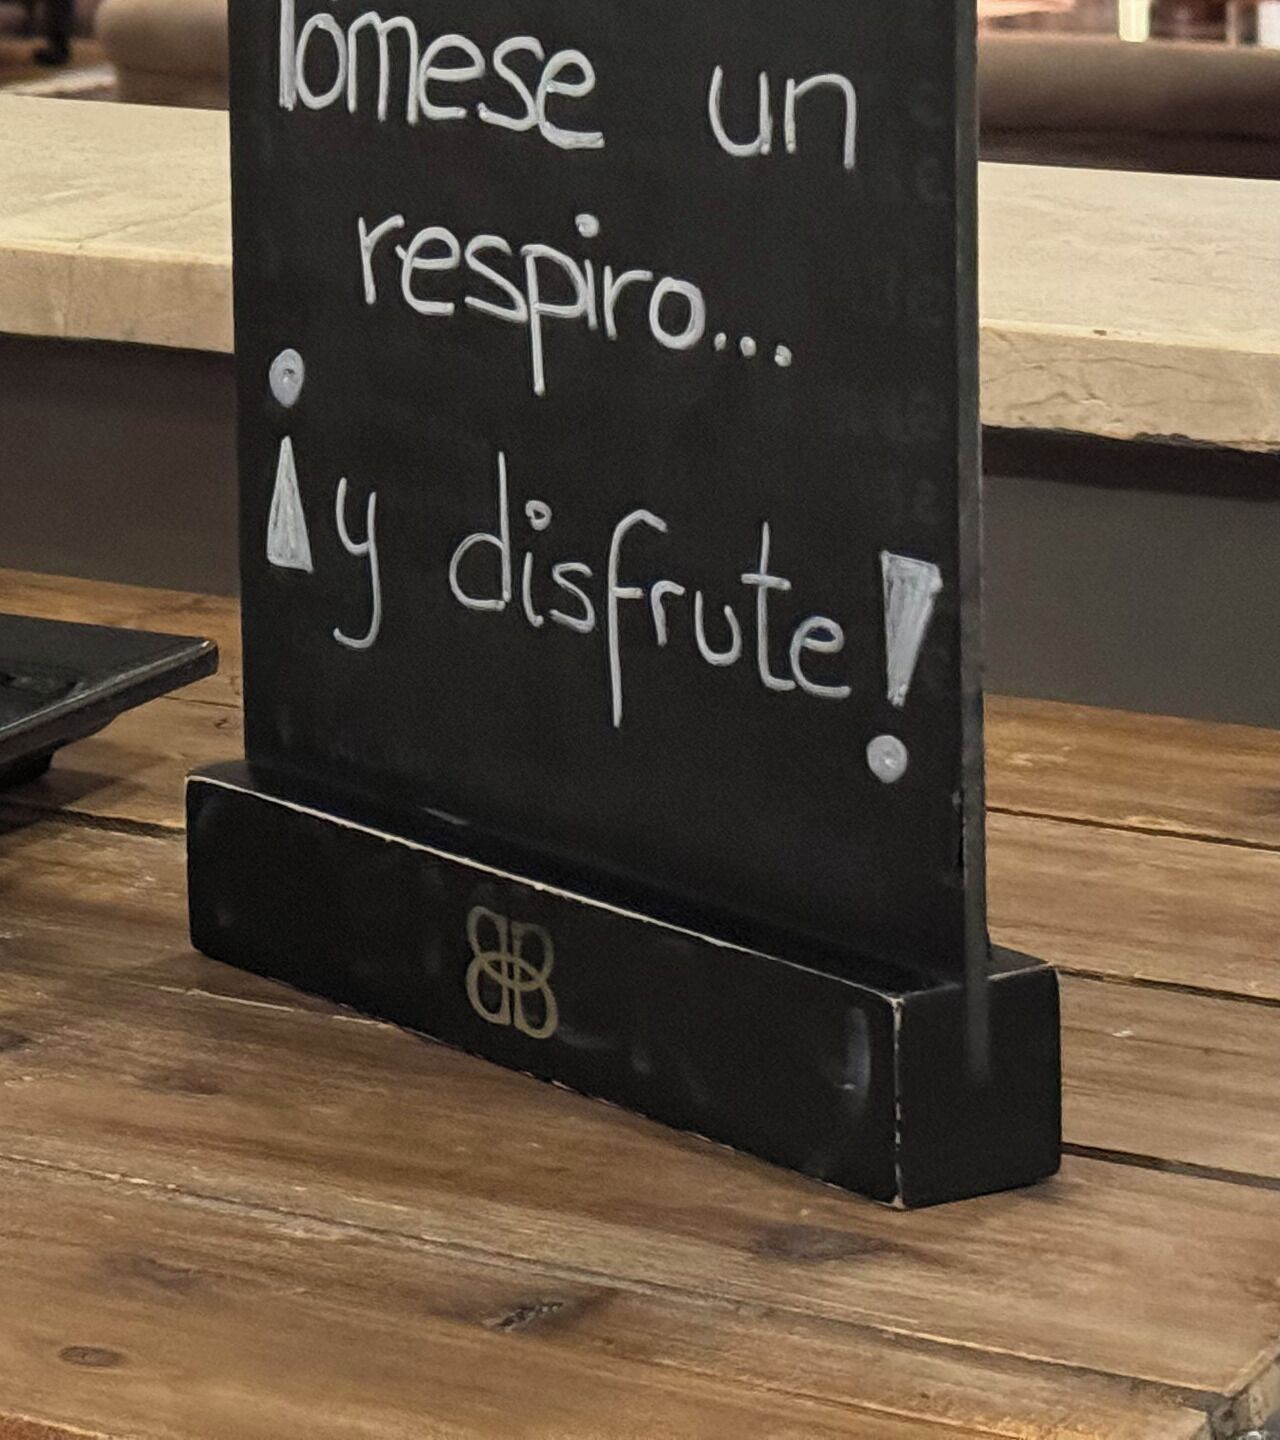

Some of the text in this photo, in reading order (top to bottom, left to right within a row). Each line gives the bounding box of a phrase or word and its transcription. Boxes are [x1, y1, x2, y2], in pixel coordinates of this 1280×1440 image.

[707, 64, 857, 171] un
[356, 212, 794, 397] respiro...
[448, 450, 944, 785] disfrute!
